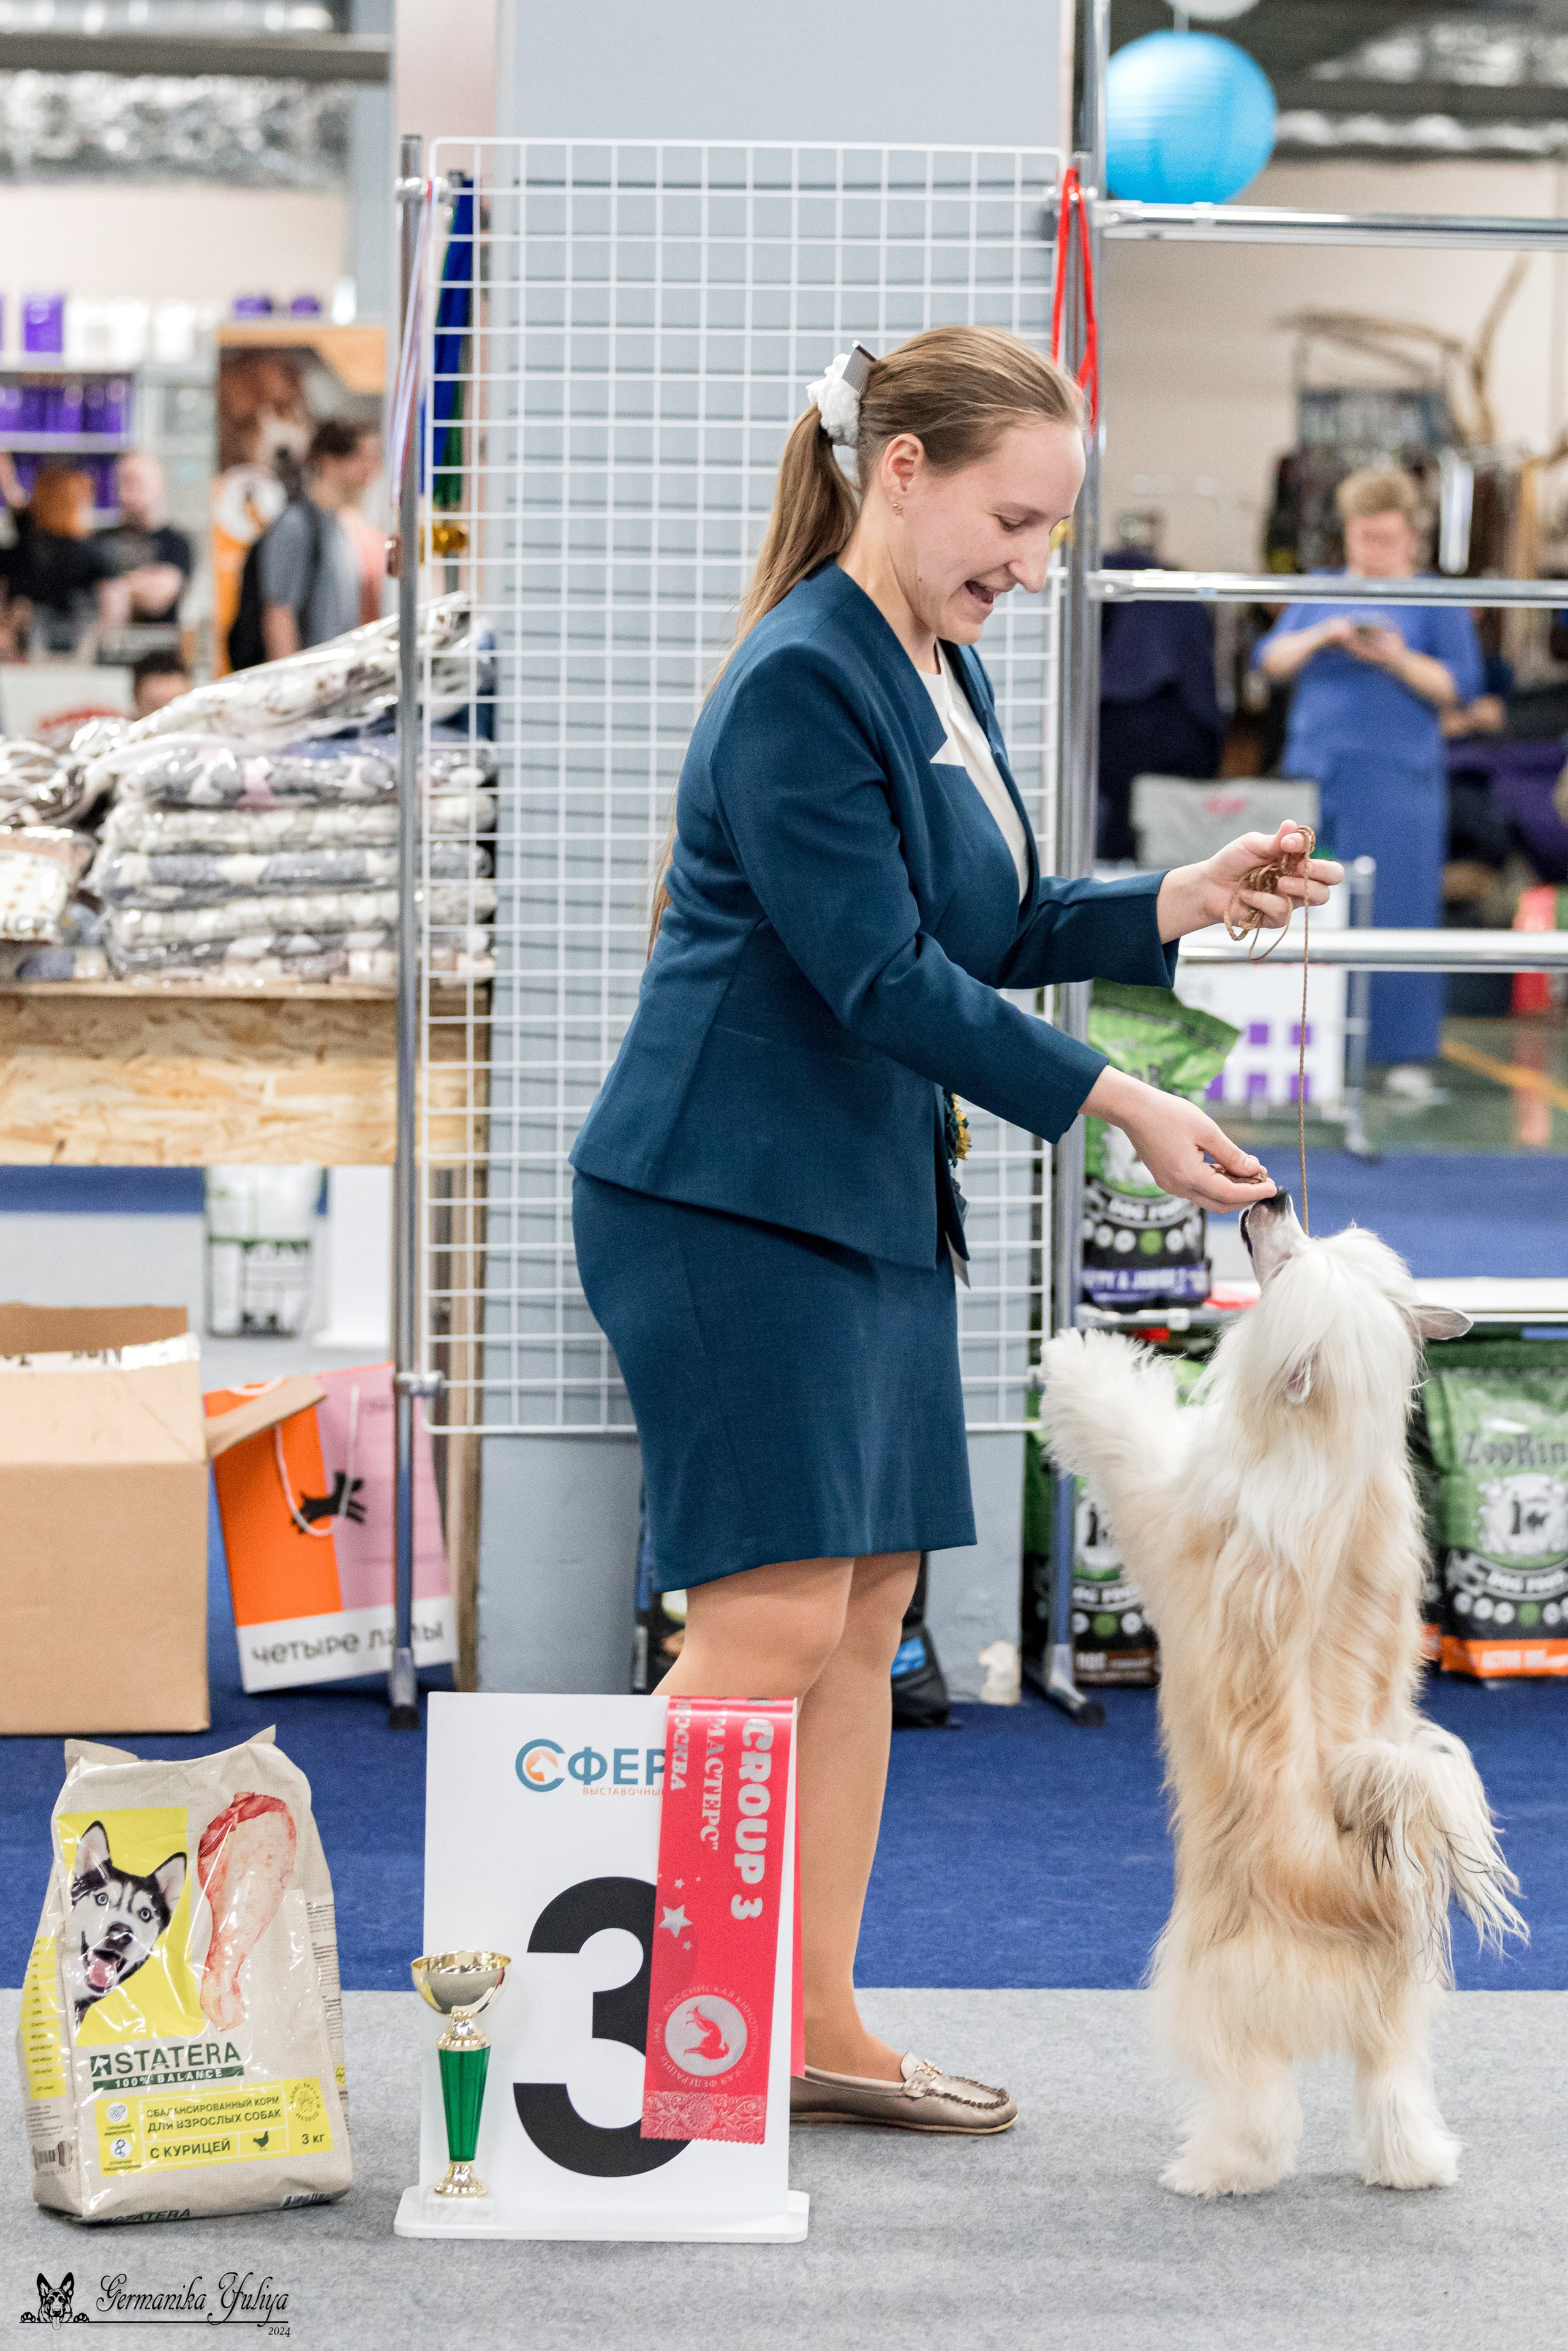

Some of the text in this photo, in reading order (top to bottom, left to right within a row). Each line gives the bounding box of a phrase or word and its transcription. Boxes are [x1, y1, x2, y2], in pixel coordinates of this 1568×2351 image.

[1464, 1432, 1568, 1465] ZooRin
[250, 1632, 360, 1666] четыре
[515, 1738, 665, 1792] СФЕР
[582, 1787, 663, 1796] ВЫСТАВОЧНЫ
[730, 1894, 763, 1920] 3
[513, 1876, 694, 2178] 3
[115, 2042, 242, 2074] STATERA
[115, 2069, 223, 2088] 100% BALANCE
[146, 2096, 280, 2118] СБАЛАНСИРОВАННЫЙ КОРМ
[148, 2121, 173, 2133] ДЛЯ
[177, 2113, 241, 2129] ВЗРОСЛЫХ
[244, 2108, 281, 2121] СОБАК
[150, 2138, 230, 2159] С КУРИЦЕЙ
[301, 2134, 325, 2145] 3 кг
